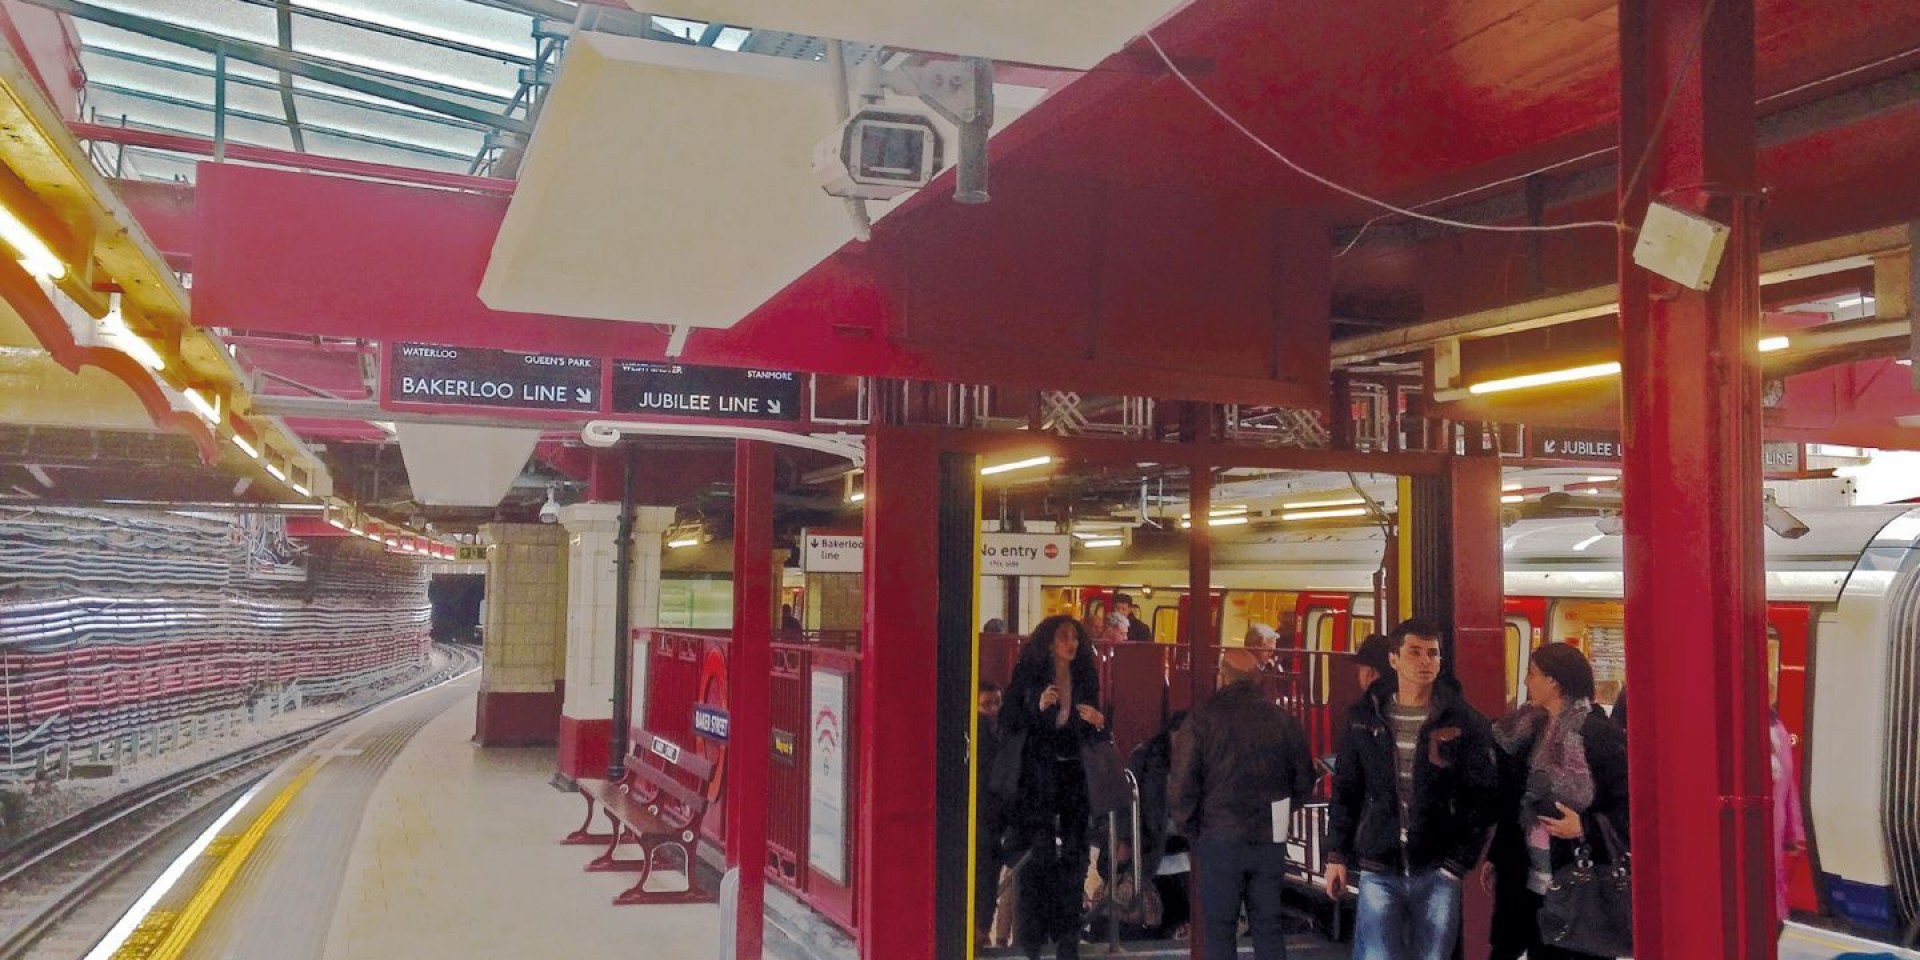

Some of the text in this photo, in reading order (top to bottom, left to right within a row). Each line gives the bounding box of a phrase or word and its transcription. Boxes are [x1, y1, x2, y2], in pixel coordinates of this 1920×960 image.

[402, 347, 457, 358] WATERLOO
[524, 356, 592, 367] QUEEN'S PARK
[747, 370, 793, 381] STANMORE
[402, 377, 567, 401] BAKERLOO LINE
[639, 392, 759, 413] JUBILEE LINE
[1560, 440, 1613, 456] JUBILEE
[1766, 452, 1793, 465] LINE
[822, 539, 864, 549] Bakerloo
[821, 550, 840, 560] line
[1001, 546, 1037, 560] entry
